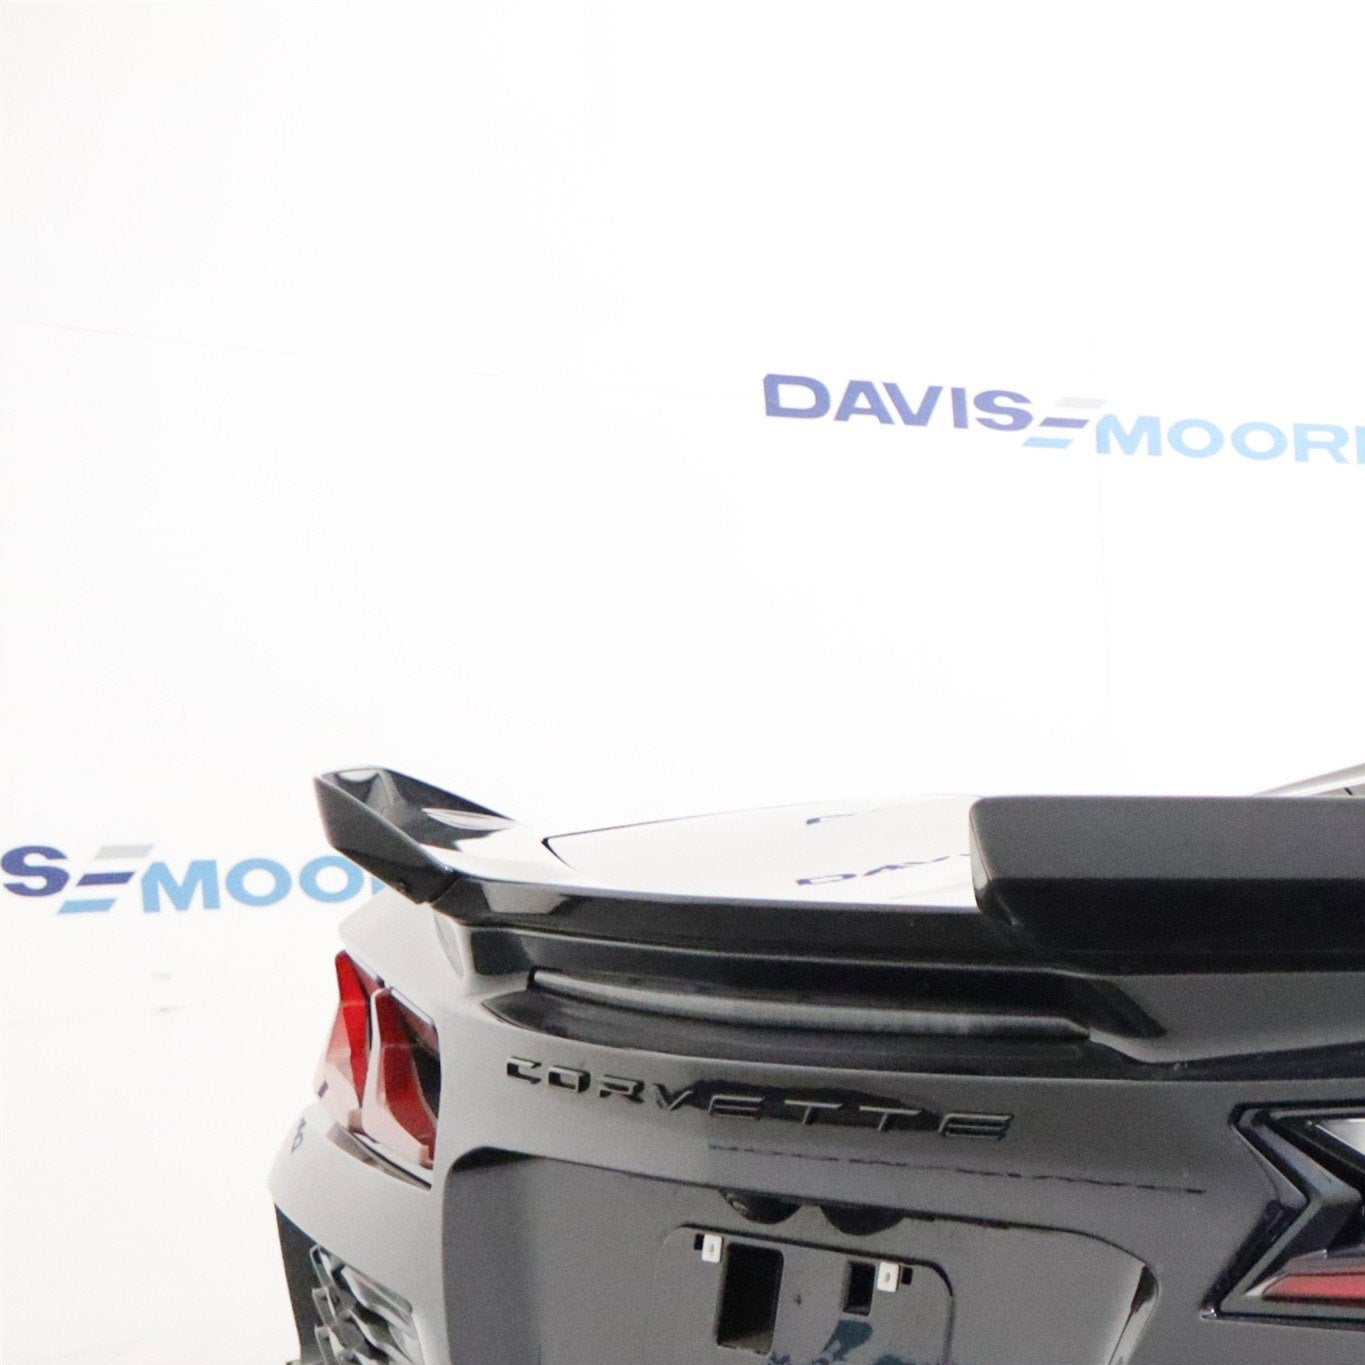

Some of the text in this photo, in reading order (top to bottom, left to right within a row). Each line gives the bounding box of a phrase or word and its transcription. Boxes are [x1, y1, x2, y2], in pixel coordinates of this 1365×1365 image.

[762, 371, 1035, 432] DAVIS
[139, 853, 388, 915] MOO
[505, 1056, 1015, 1141] CORVETTE
